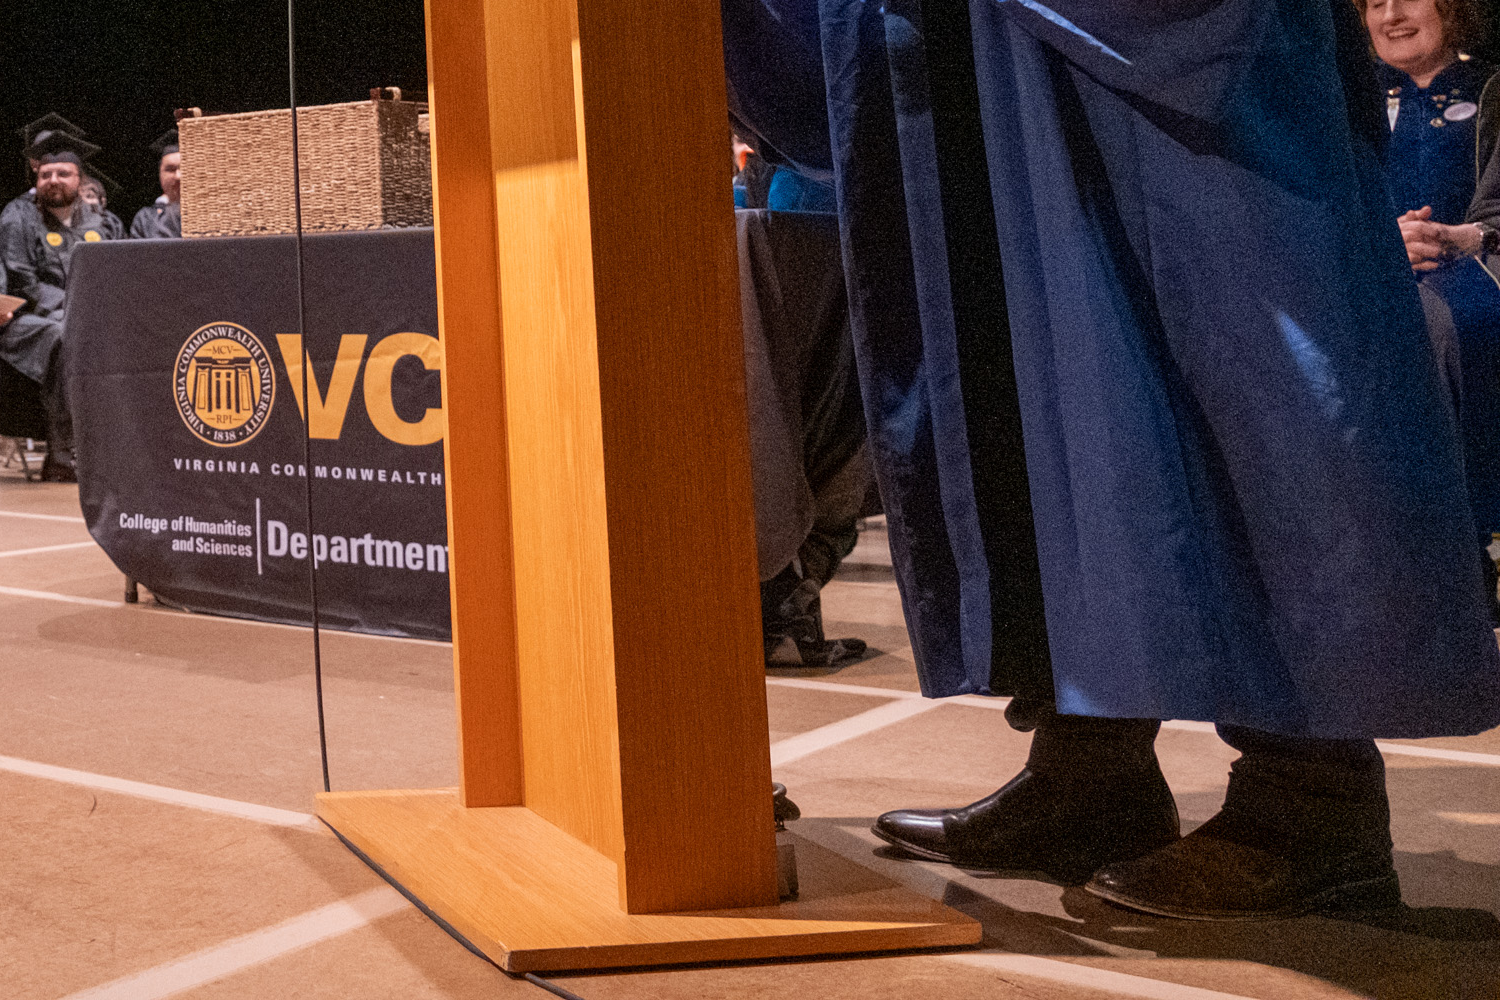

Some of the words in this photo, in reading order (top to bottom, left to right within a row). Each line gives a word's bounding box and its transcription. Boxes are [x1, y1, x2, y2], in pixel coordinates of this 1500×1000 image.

[179, 326, 263, 373] COMMONWEALTH
[212, 345, 234, 355] MCV
[177, 375, 206, 435] VIRGINIA
[245, 358, 272, 436] UNIVERSITY
[216, 415, 232, 424] RPI
[213, 430, 237, 441] 1838
[173, 458, 261, 475] VIRGINIA
[271, 463, 442, 486] COMMONWEALTH
[119, 513, 168, 533] College
[171, 516, 184, 531] of
[184, 516, 252, 538] Humanities
[172, 538, 194, 553] and
[195, 538, 253, 557] Sciences
[267, 519, 451, 573] Departmen
